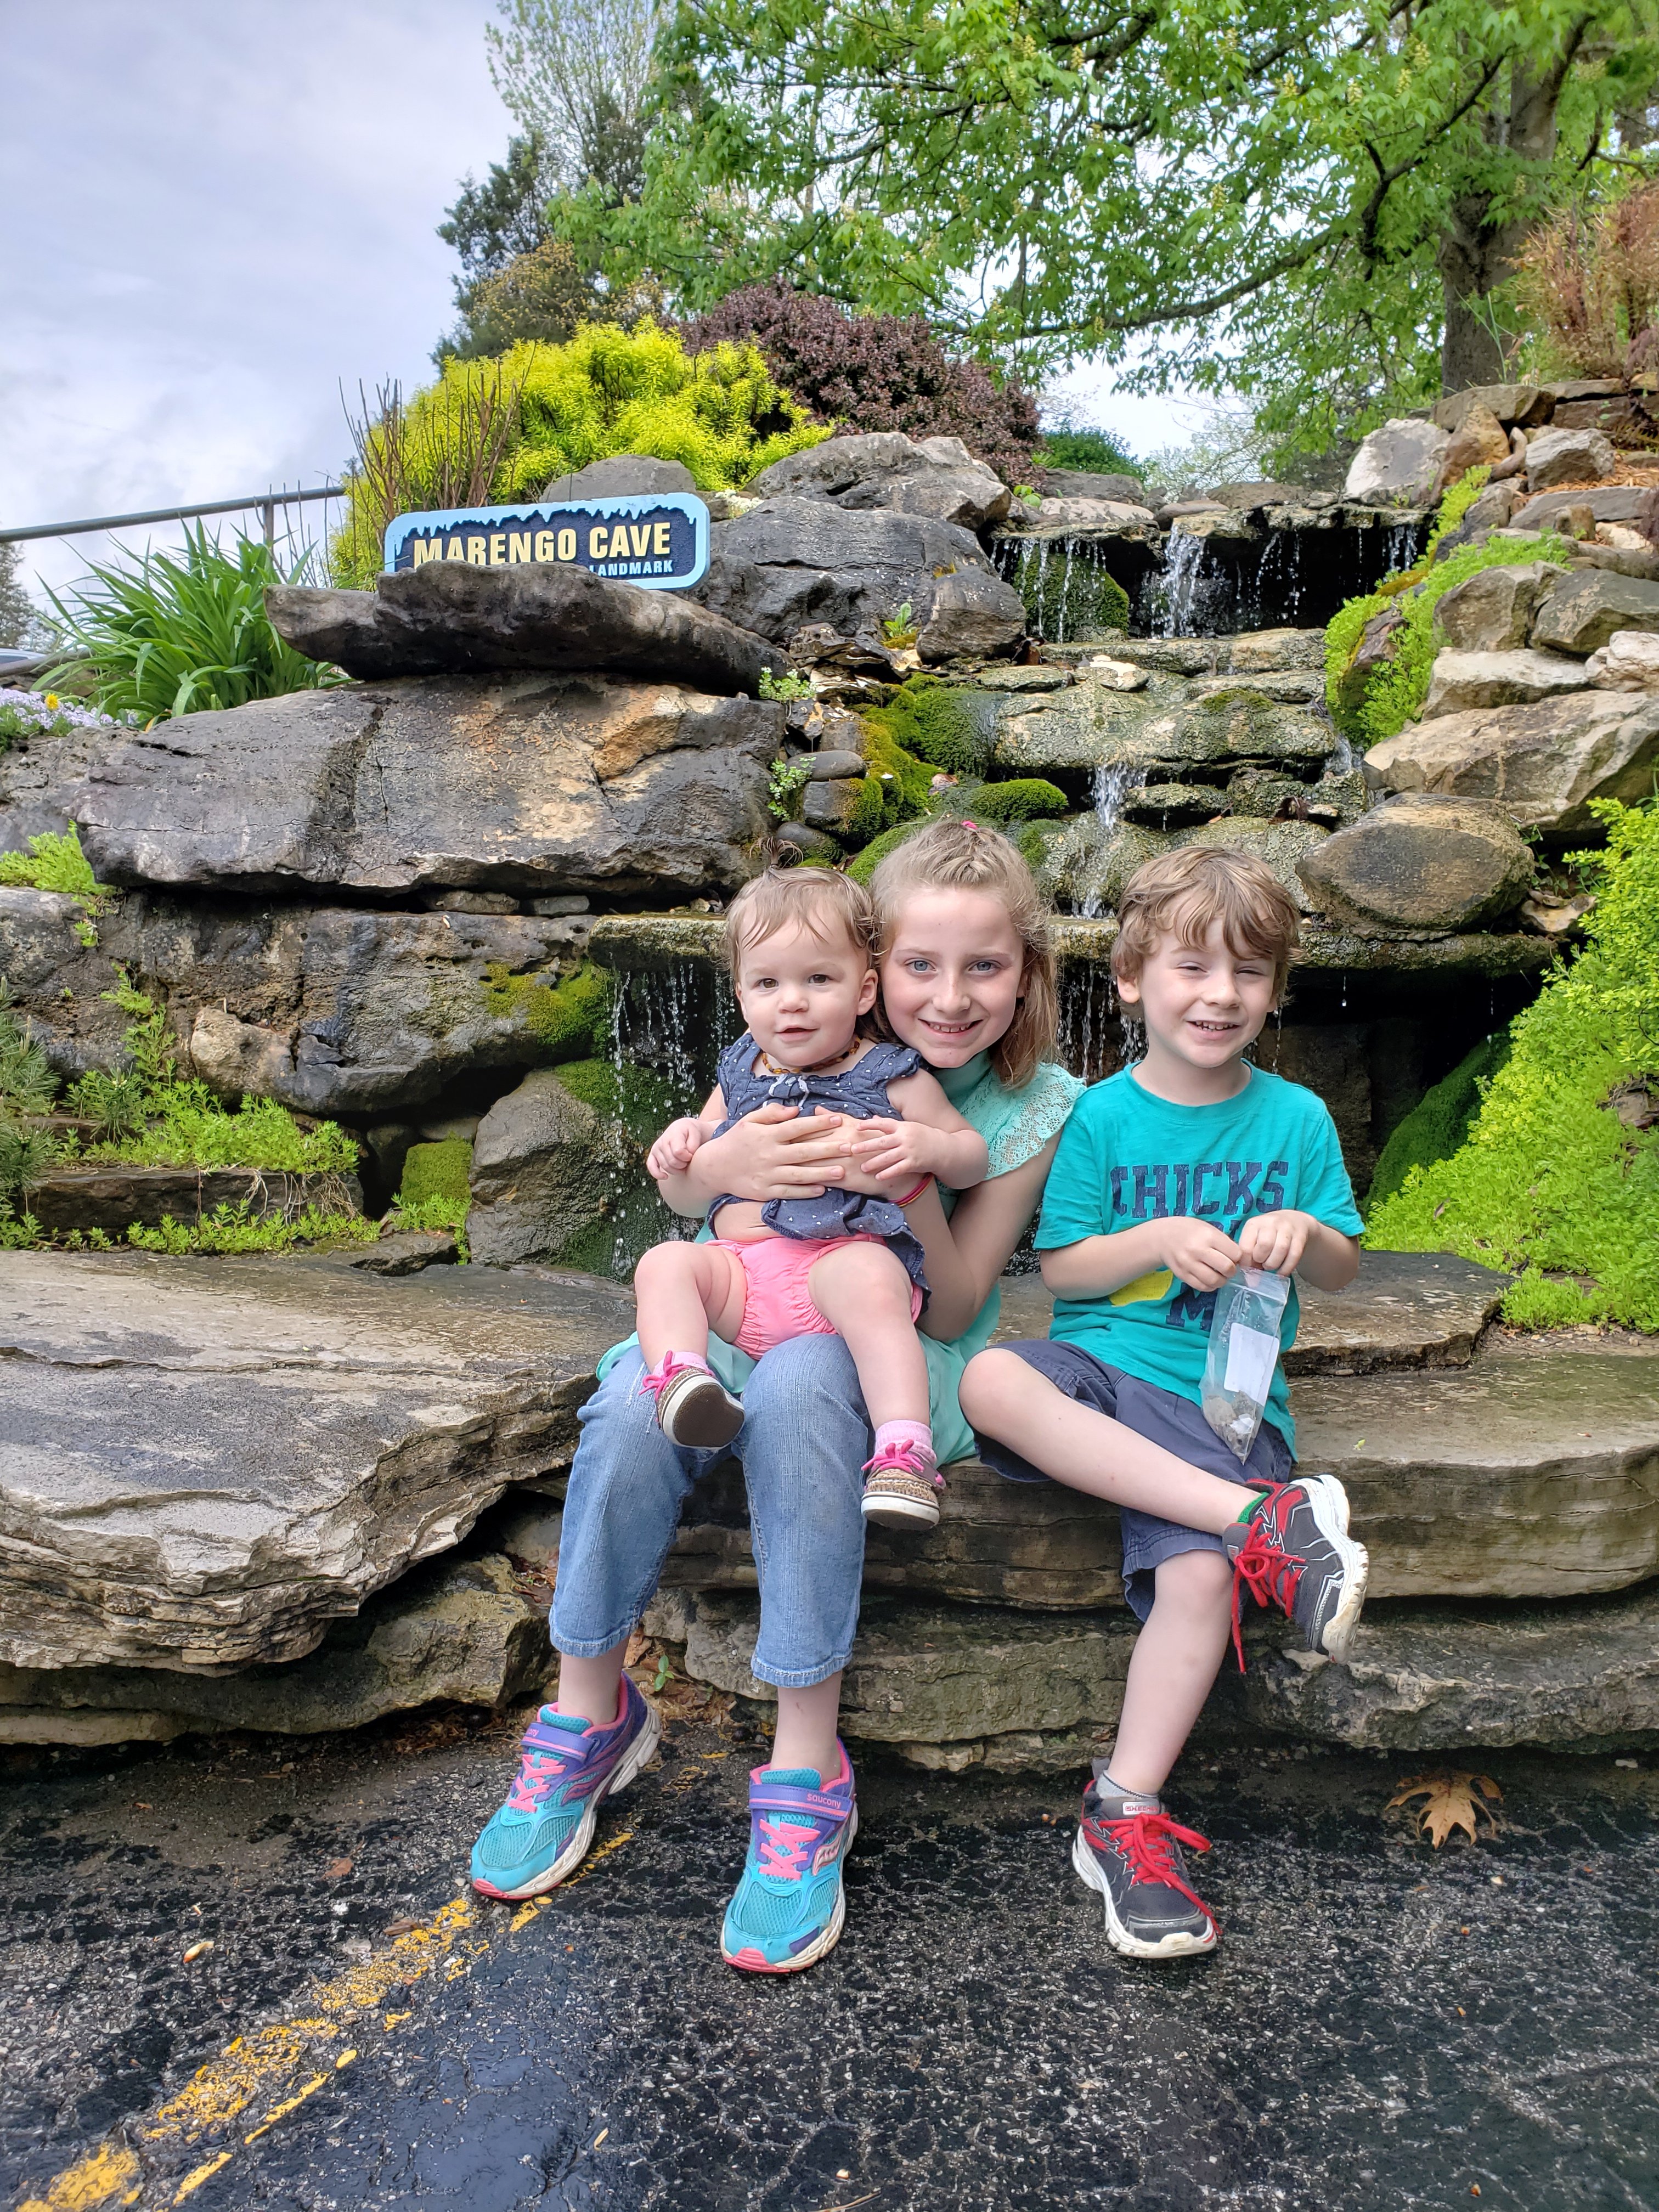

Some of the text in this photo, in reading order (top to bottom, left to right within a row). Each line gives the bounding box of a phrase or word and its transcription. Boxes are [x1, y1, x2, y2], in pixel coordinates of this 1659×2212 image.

[414, 522, 670, 569] MARENGO CAVE
[1110, 1161, 1289, 1218] CHICKS
[807, 1793, 841, 1809] saucony
